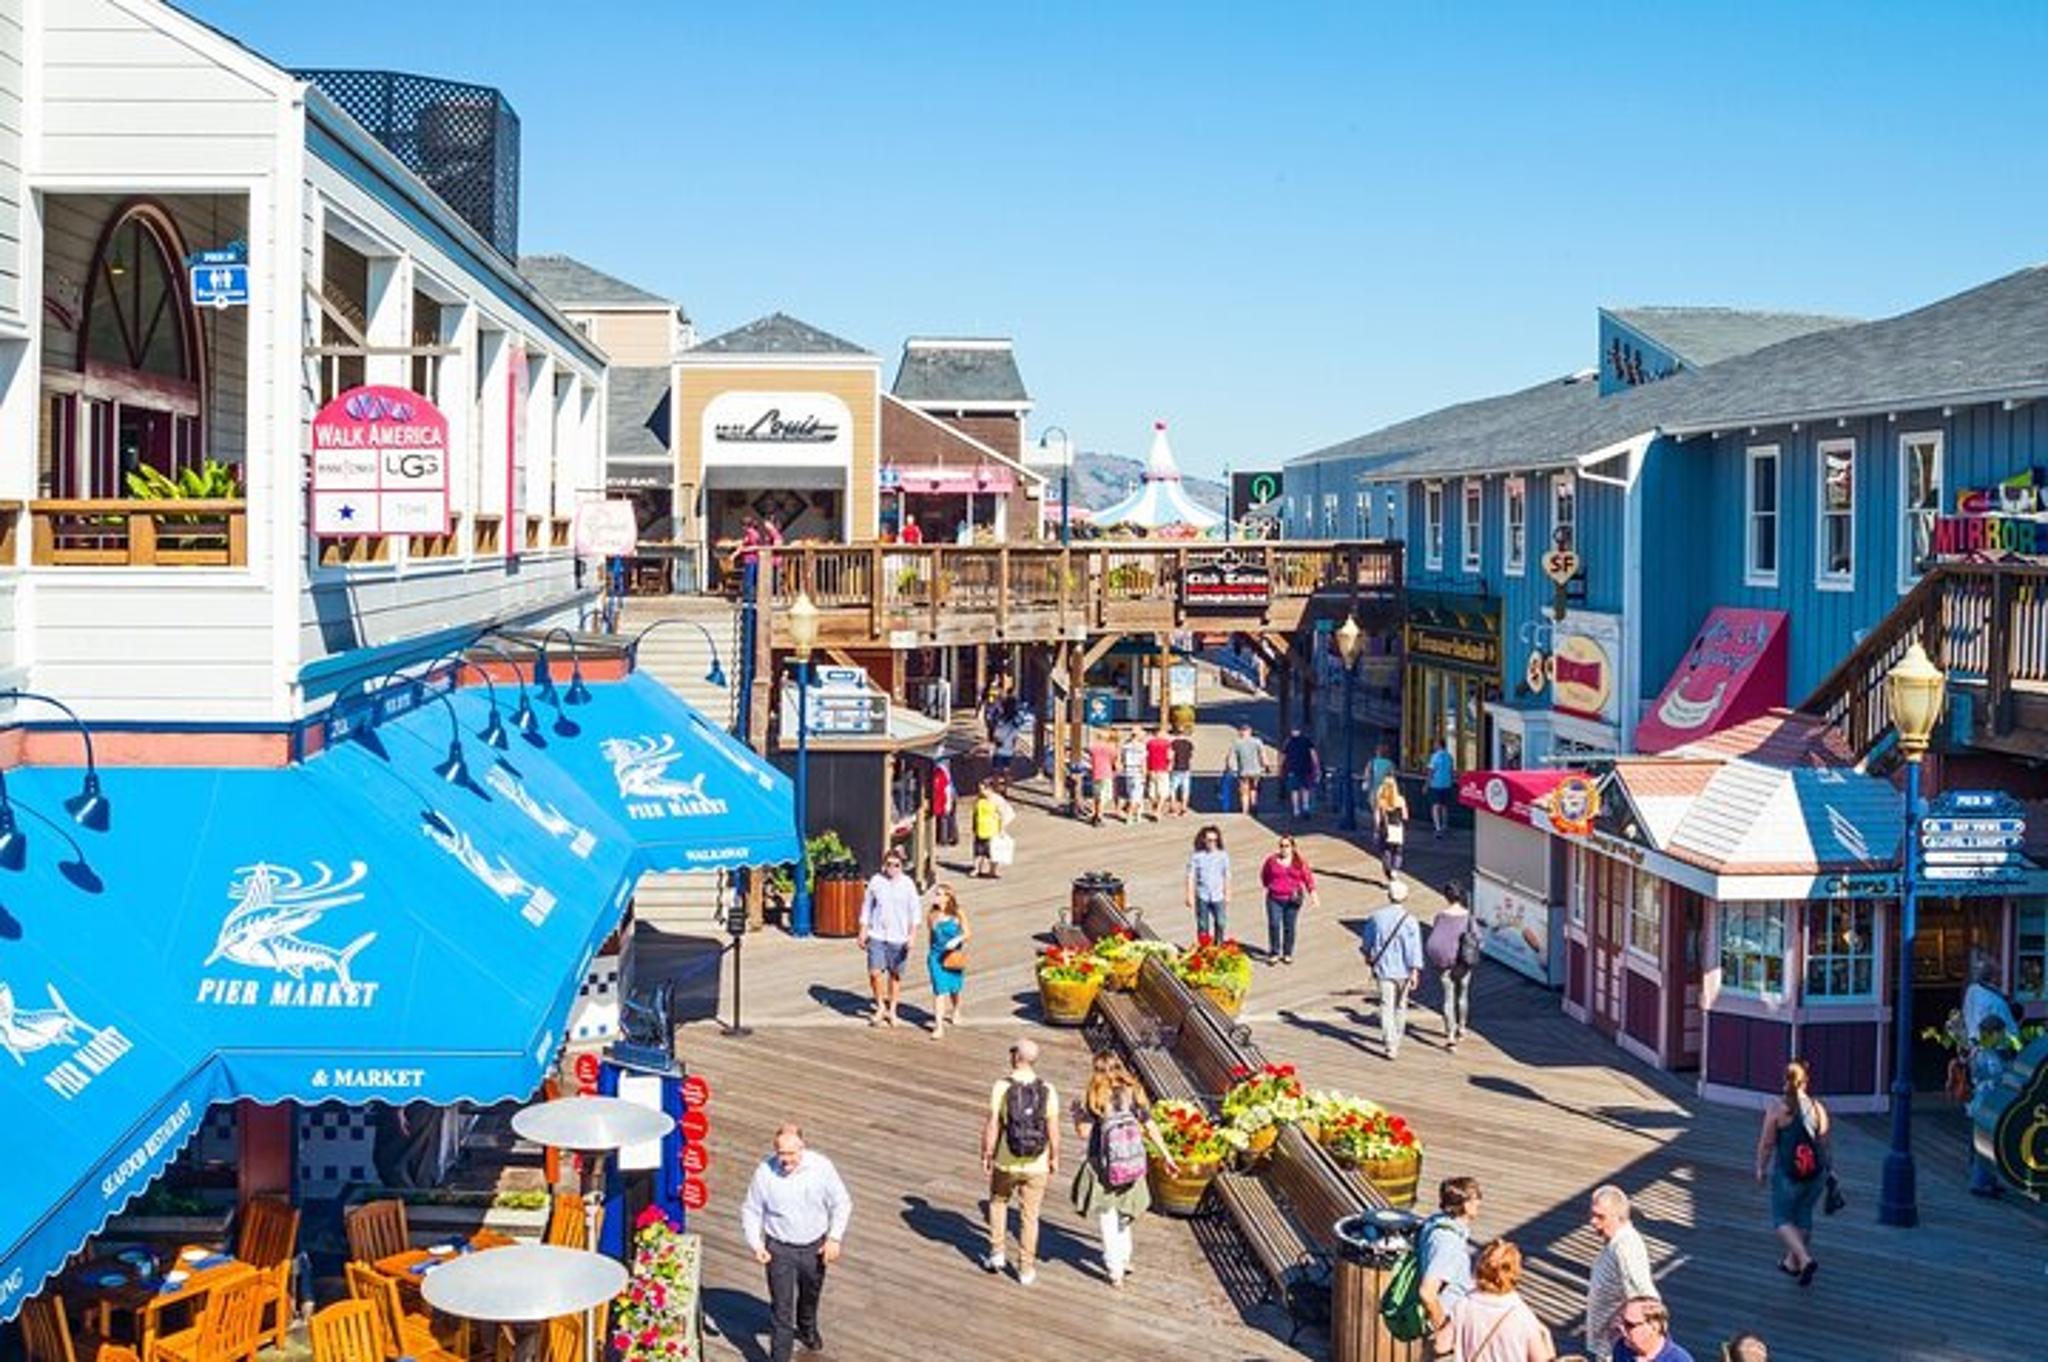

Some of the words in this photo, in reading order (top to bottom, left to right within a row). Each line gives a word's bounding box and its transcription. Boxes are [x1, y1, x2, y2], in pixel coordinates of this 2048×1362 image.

[314, 421, 365, 447] WALK
[368, 420, 442, 447] AMERICA
[745, 408, 838, 437] Louis
[385, 454, 439, 479] UGG
[1934, 517, 2036, 556] MIRROR
[1549, 555, 1575, 573] SF
[626, 802, 666, 820] PIER
[197, 978, 260, 1005] PIER
[270, 981, 379, 1008] MARKET
[44, 1060, 92, 1101] PIER
[73, 1024, 135, 1076] MARKET
[311, 1069, 328, 1087] &
[334, 1069, 424, 1088] MARKET
[101, 1147, 149, 1200] SEAFOOD
